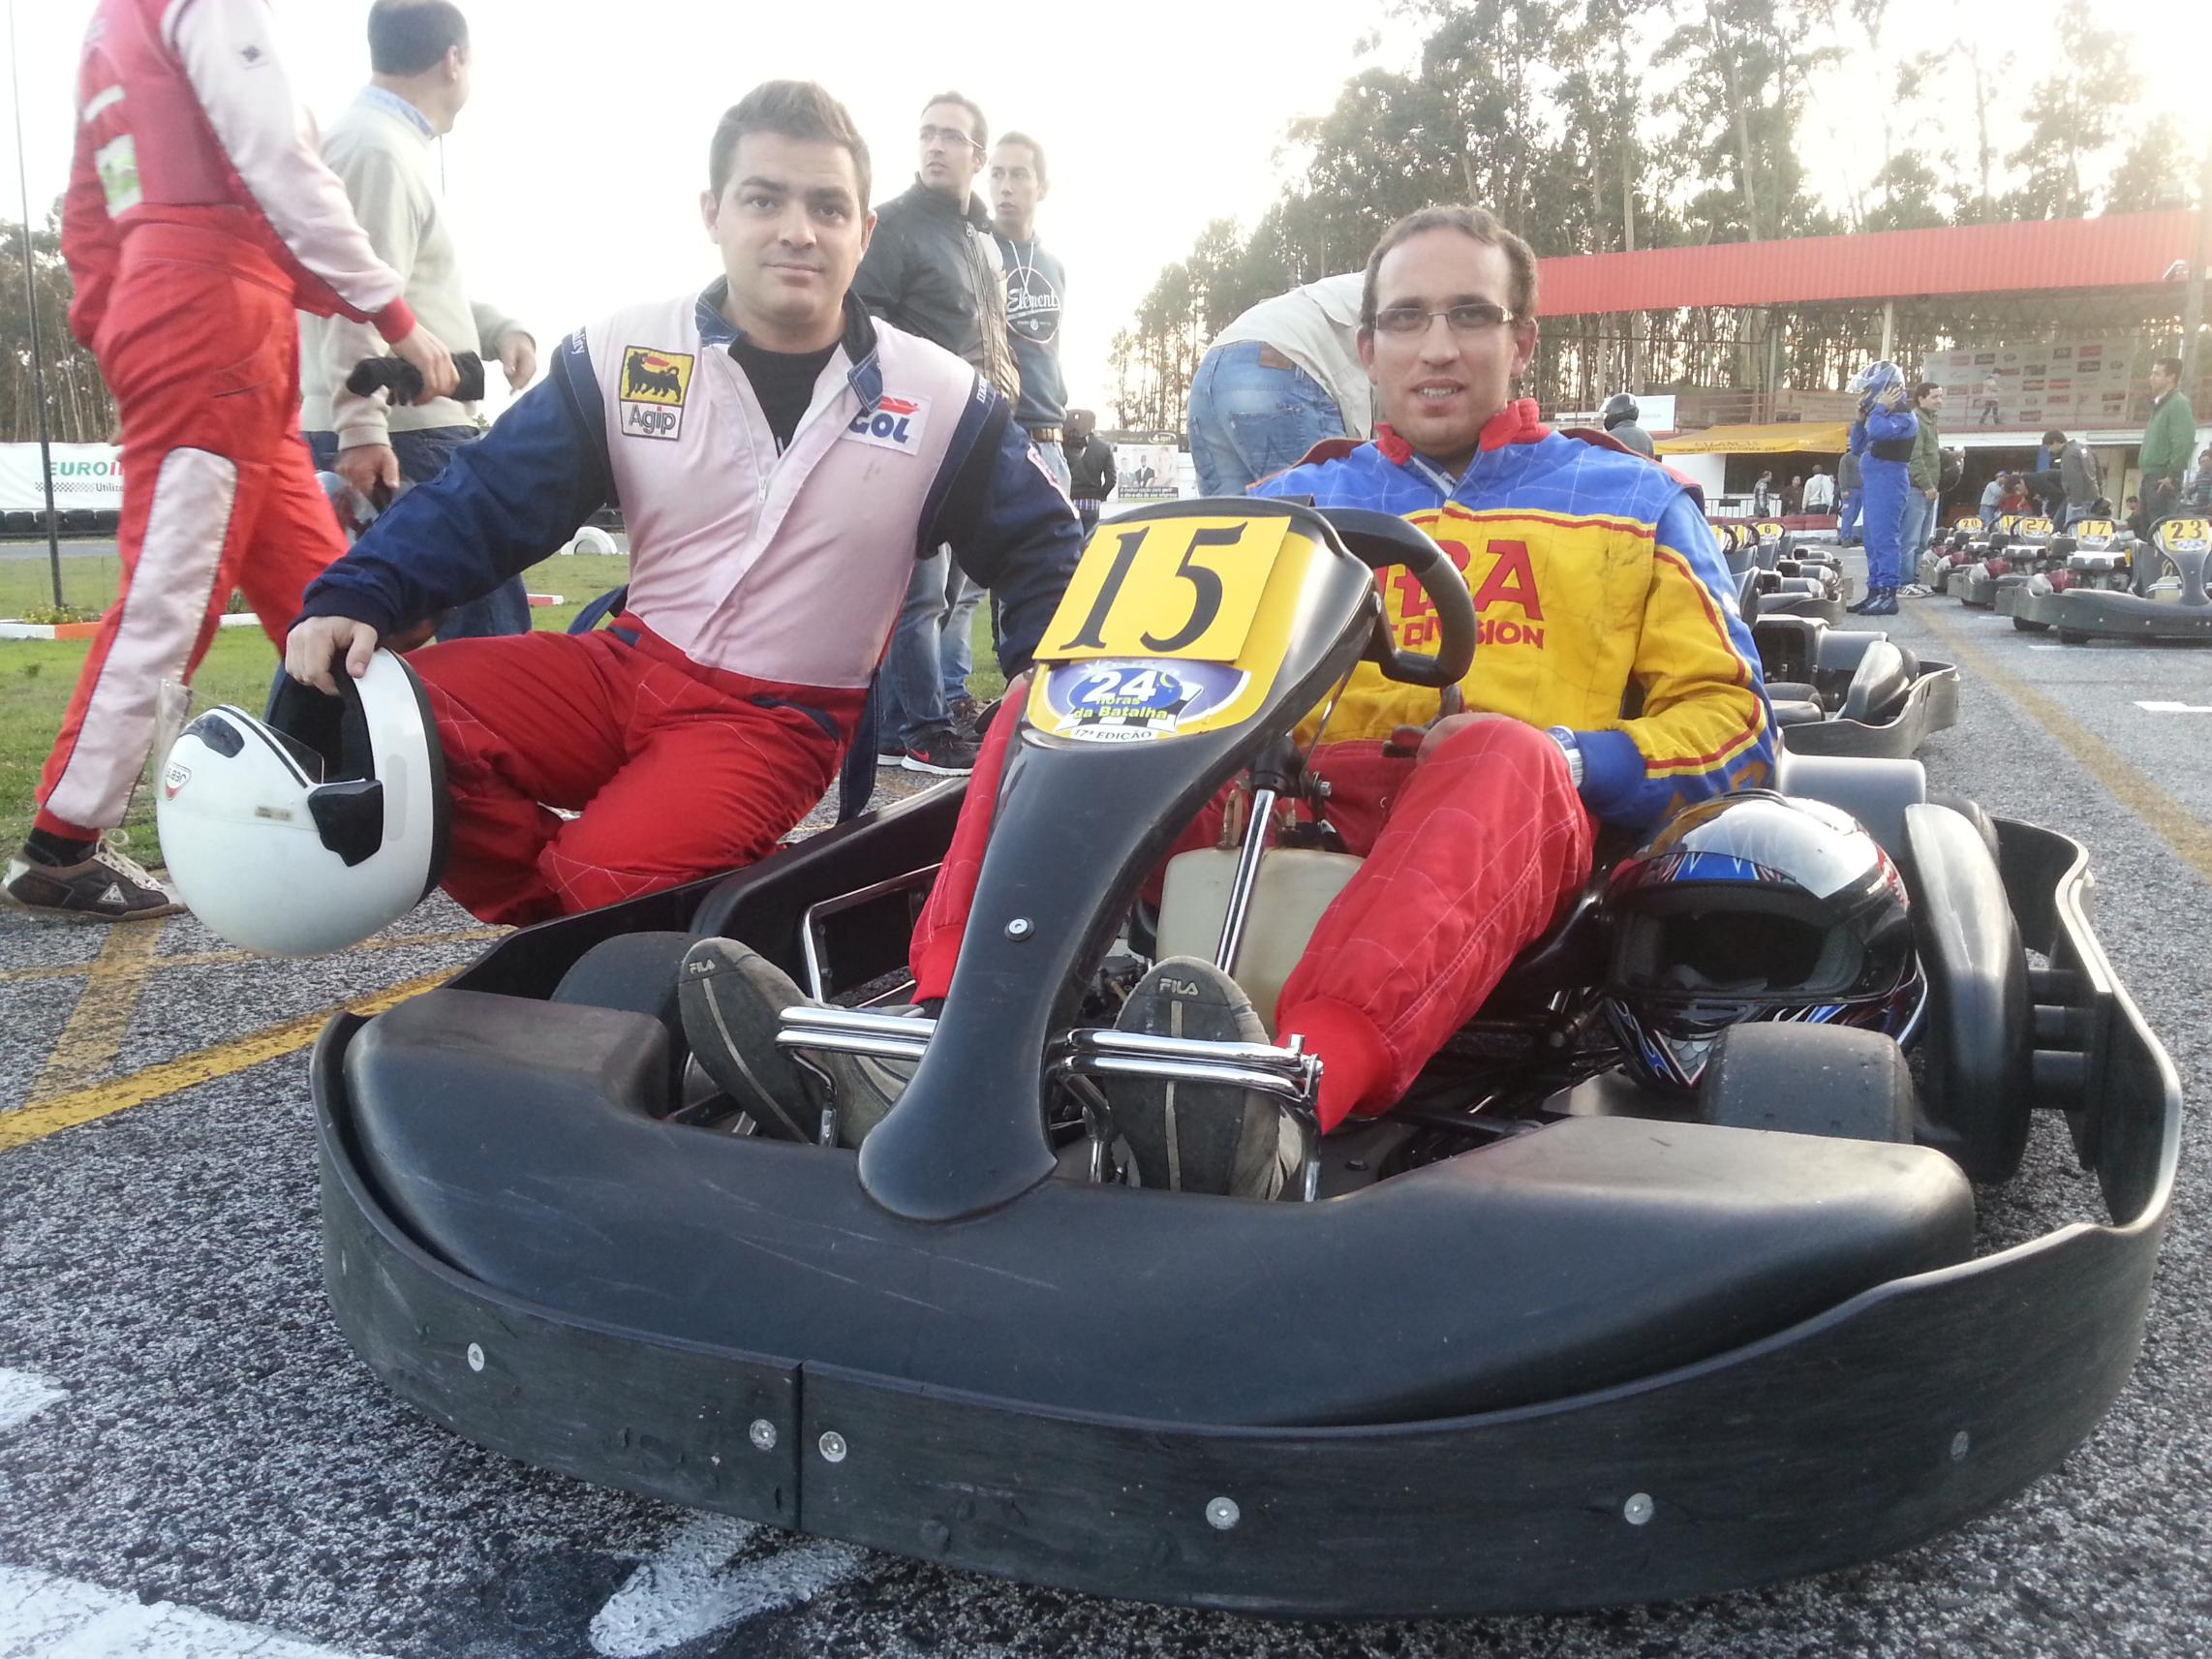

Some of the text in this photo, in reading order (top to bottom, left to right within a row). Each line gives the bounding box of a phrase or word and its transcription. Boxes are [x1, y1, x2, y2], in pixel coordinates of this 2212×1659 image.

[1007, 288, 1059, 312] Element
[630, 403, 676, 435] Agip
[848, 411, 909, 444] GOL
[1765, 525, 1771, 534] 6
[2026, 518, 2048, 531] 27
[2085, 521, 2107, 535] 17
[2170, 520, 2203, 539] 23
[1059, 521, 1248, 653] 15
[1403, 616, 1544, 650] DISION
[1082, 670, 1157, 703] 24
[1095, 693, 1141, 706] horas
[1072, 706, 1169, 721] da Batalha
[1095, 730, 1152, 740] EDIÇÃO
[689, 959, 716, 974] FILA
[1159, 977, 1199, 996] FILA
